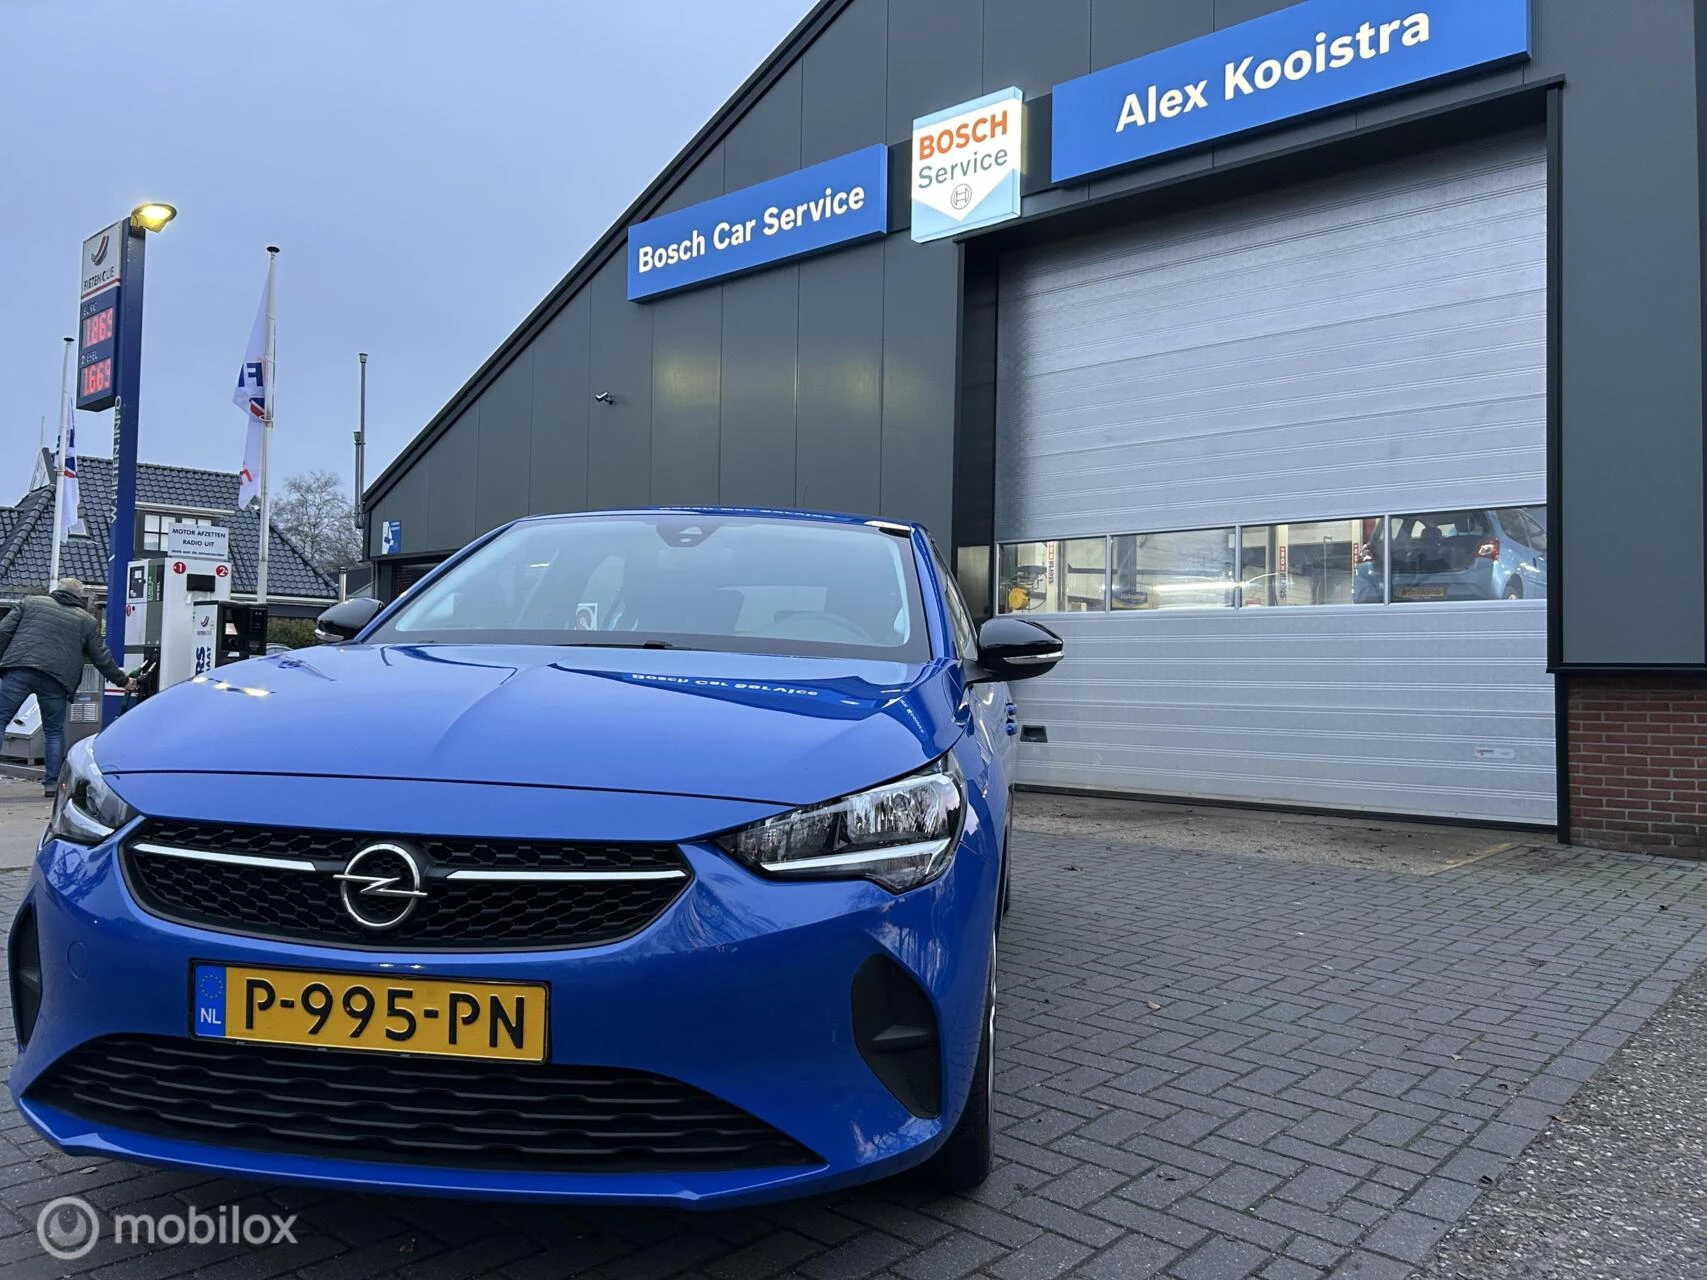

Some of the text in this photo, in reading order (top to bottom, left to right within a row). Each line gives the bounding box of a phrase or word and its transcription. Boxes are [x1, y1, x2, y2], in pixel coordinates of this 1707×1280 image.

[1115, 12, 1430, 133] Alex Kooistra
[919, 110, 1008, 161] BOSCH
[918, 149, 1008, 189] Service
[638, 186, 865, 273] Bosch Car Service
[172, 528, 226, 539] MOTOR AFZETTEN
[182, 539, 203, 547] RADIO
[219, 566, 226, 576] 2
[200, 1007, 221, 1025] NL
[245, 977, 525, 1049] P-995-PN
